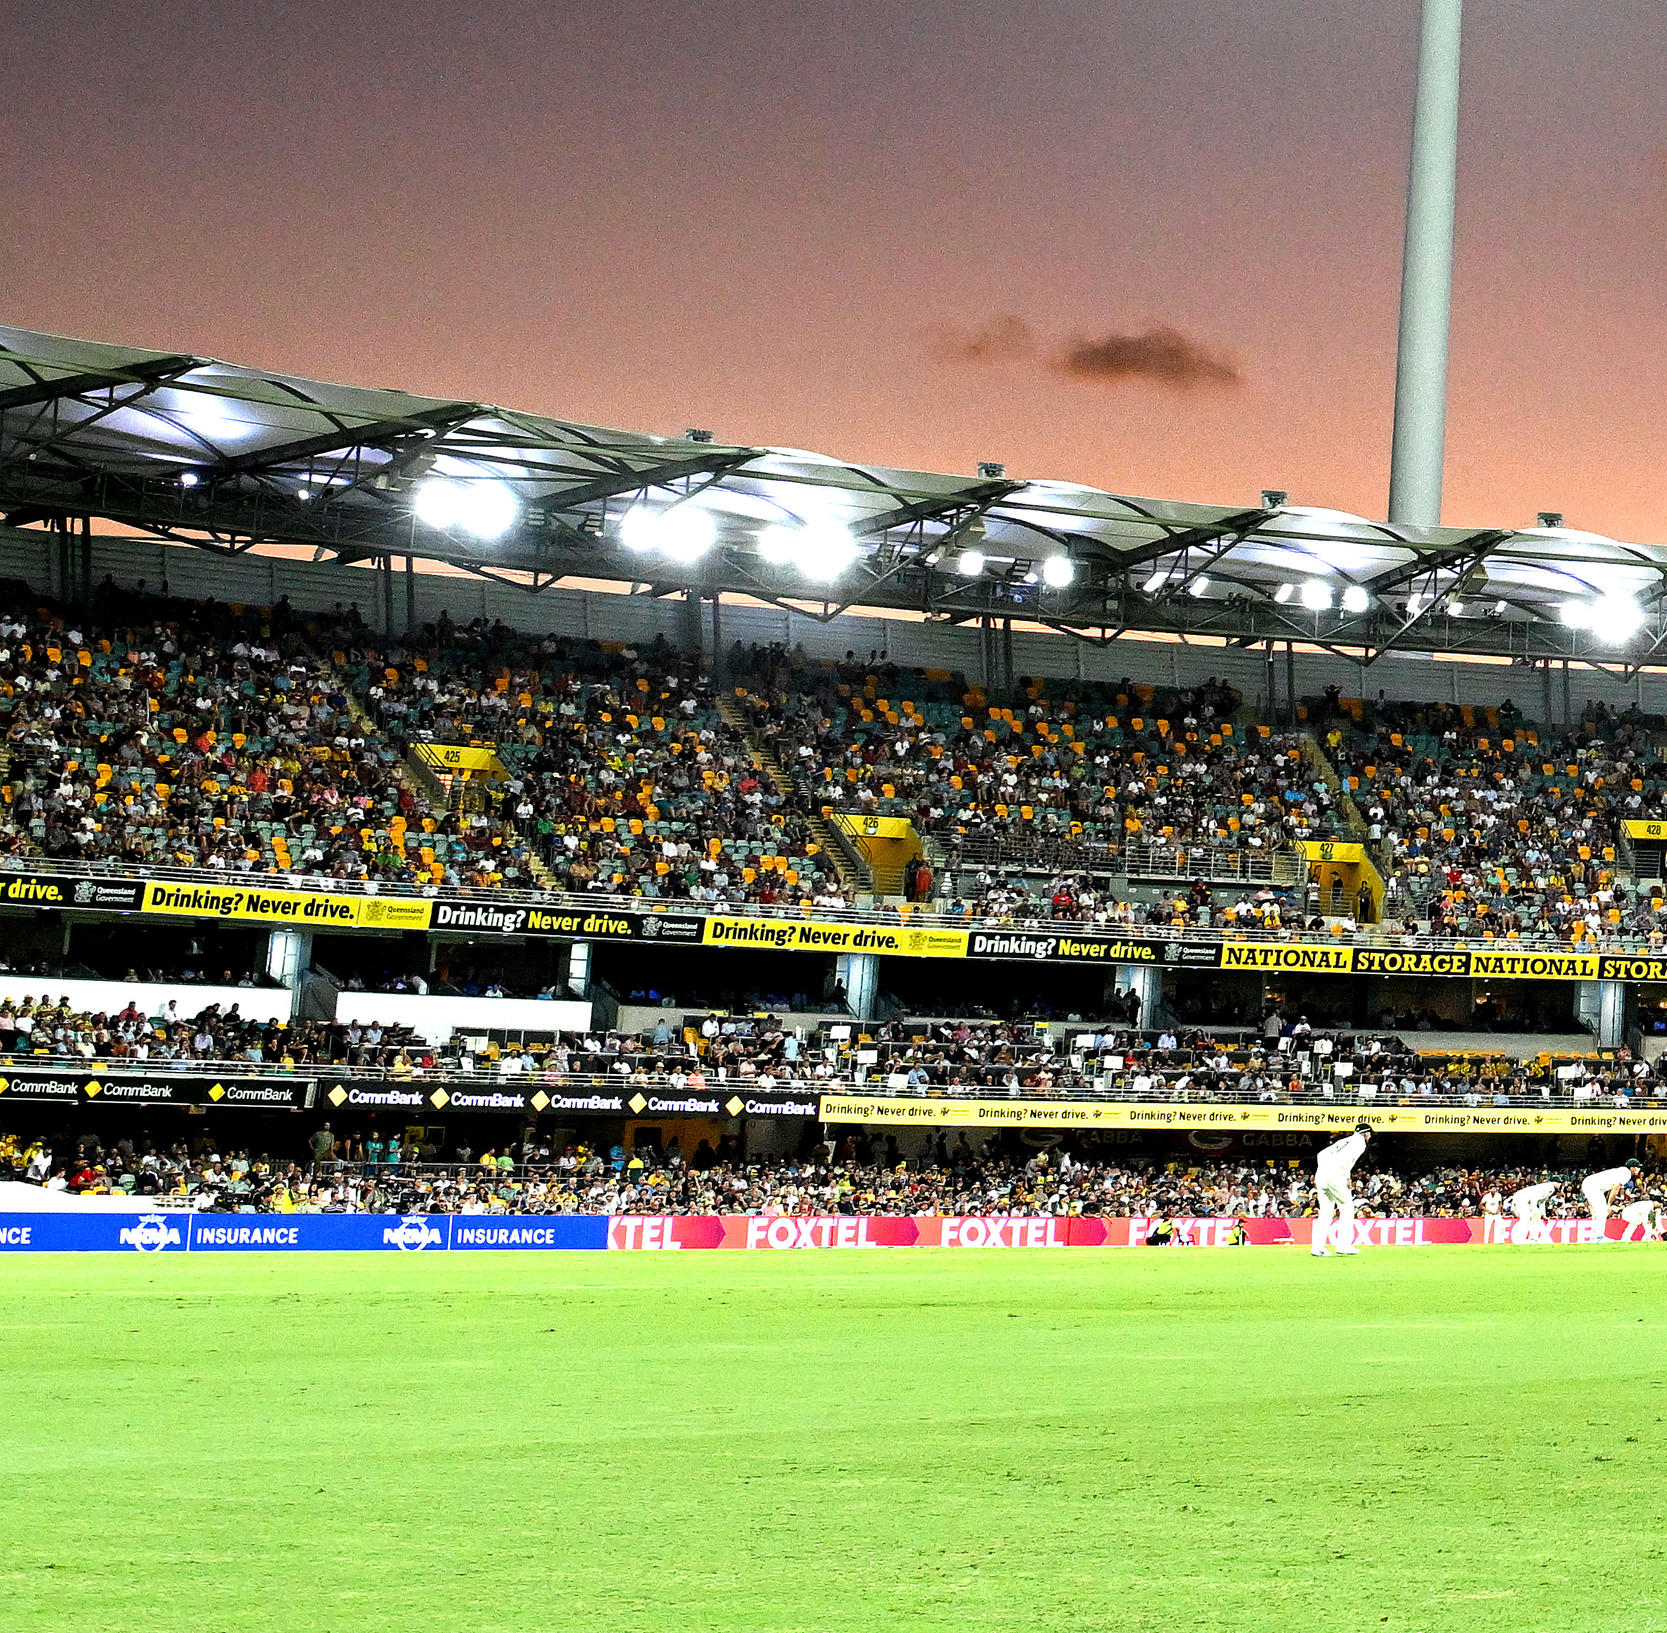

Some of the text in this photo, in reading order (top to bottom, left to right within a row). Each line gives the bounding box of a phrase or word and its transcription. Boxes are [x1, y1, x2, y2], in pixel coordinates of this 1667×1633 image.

[444, 750, 460, 763] 425
[863, 816, 878, 828] 426
[1647, 825, 1661, 836] 428
[1320, 843, 1334, 854] 427
[8, 878, 63, 901] drive.
[97, 886, 136, 896] Queensland
[151, 886, 355, 920] Drinking? Never drive.
[387, 904, 425, 916] Queensland
[437, 904, 632, 935] Drinking? Never drive.
[663, 921, 698, 930] Queensland
[712, 922, 899, 950] Drinking? Never drive.
[928, 935, 962, 944] Queensland
[974, 935, 1156, 960] Drinking? Never drive.
[1182, 946, 1216, 956] Queensland
[1227, 947, 1466, 973] NATIONAL STORAGE
[1474, 956, 1594, 978] NATIONAL
[11, 1078, 78, 1094] CommBank
[104, 1082, 172, 1098] CommBank
[227, 1087, 292, 1102] CommBank
[348, 1089, 423, 1106] CommBank
[451, 1092, 525, 1109] CommBank
[551, 1094, 623, 1111] CommBank
[647, 1096, 719, 1114] CommBank
[745, 1099, 817, 1116] CommBank
[825, 1103, 936, 1118] Drinking? Never drive.
[1424, 1114, 1530, 1127] Drinking? Never drive.
[120, 1227, 299, 1245] NRMA INSURANCE
[383, 1227, 556, 1245] NRMA INSURANCE
[747, 1218, 877, 1248] FOXTEL
[941, 1218, 1064, 1246] FOXTEL
